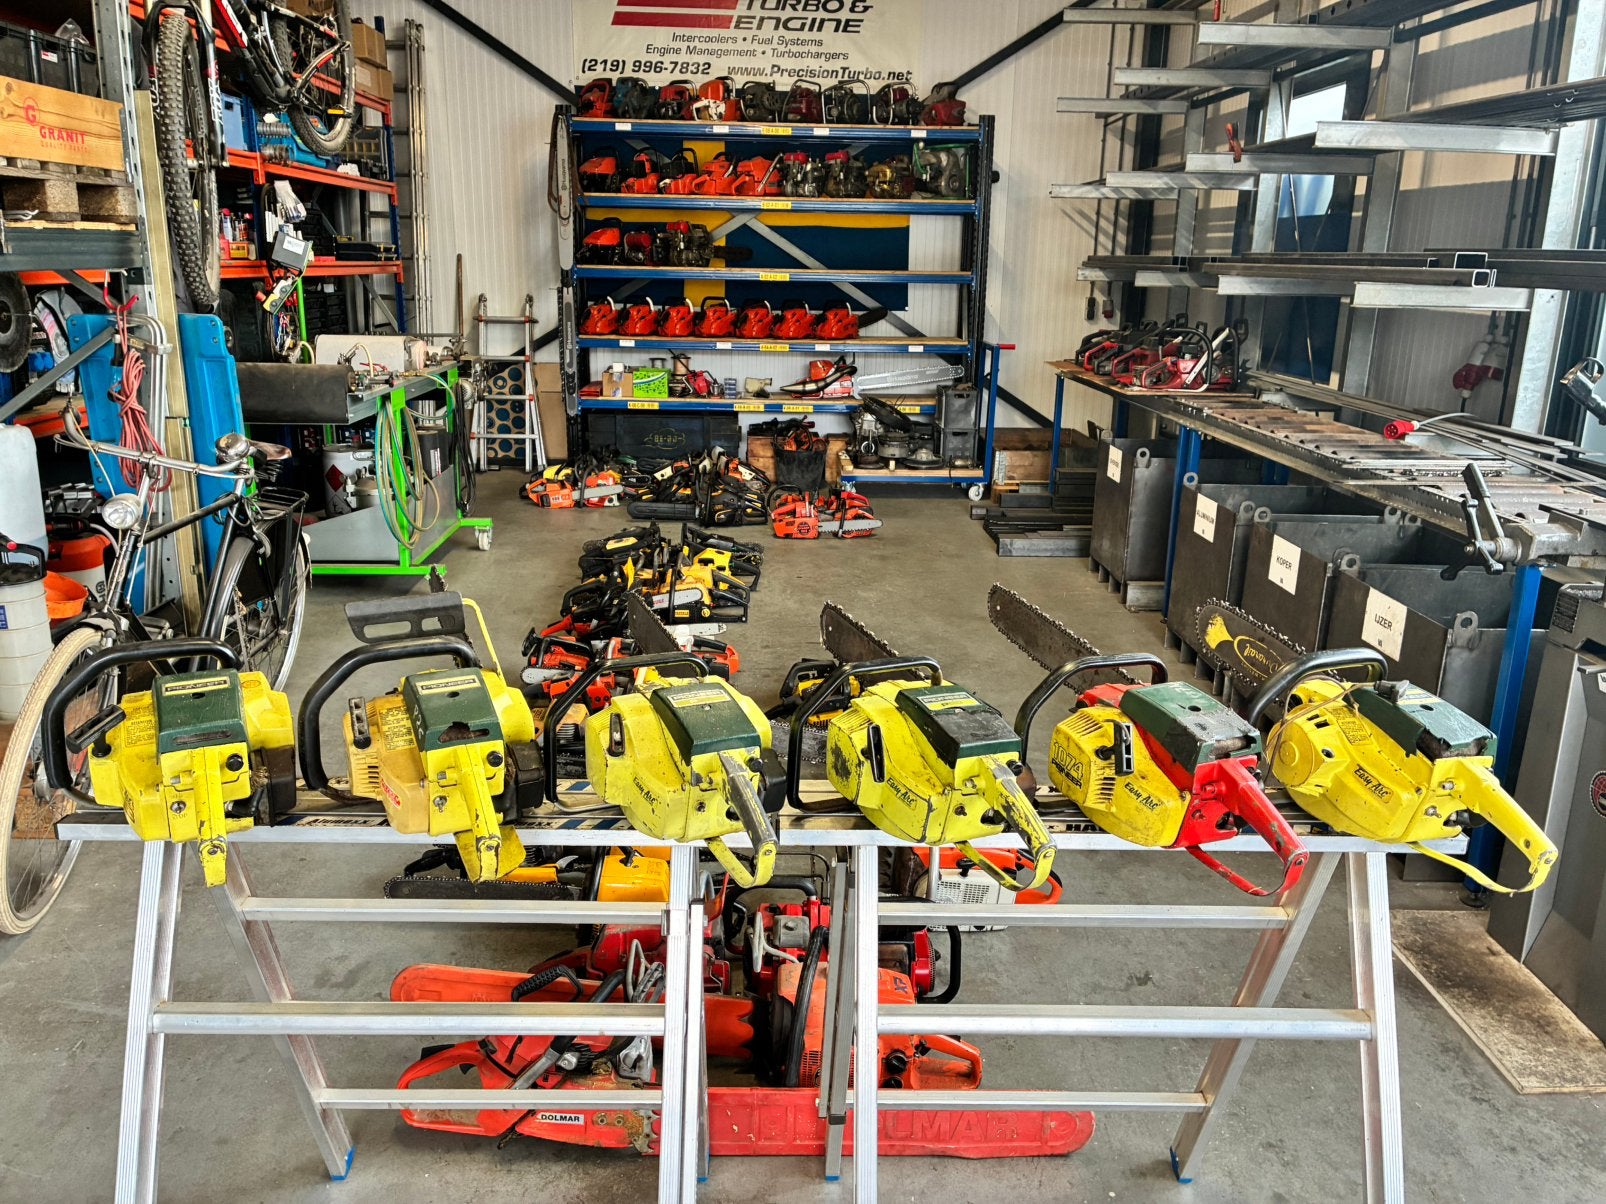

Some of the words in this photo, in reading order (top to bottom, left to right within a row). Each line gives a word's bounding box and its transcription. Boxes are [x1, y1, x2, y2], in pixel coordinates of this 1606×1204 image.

[746, 0, 845, 13] TURBO
[734, 15, 864, 33] ENGINE
[672, 32, 738, 44] Intercoolers
[751, 36, 774, 45] Fuel
[777, 36, 823, 48] Systems
[645, 44, 682, 57] Engine
[685, 46, 757, 58] Management
[771, 48, 849, 62] Turbochargers
[581, 58, 626, 75] (219)
[632, 60, 711, 75] 996-7832
[727, 64, 913, 81] www.PrecisionTurbo.net
[40, 125, 86, 145] GRANIT
[1276, 555, 1292, 572] KOPER
[1374, 613, 1393, 631] IJZER
[167, 680, 227, 692] PIONEER
[421, 678, 476, 691] PIONEER
[1053, 742, 1085, 780] 1074
[1052, 758, 1082, 789] PIONEER
[1354, 765, 1373, 787] Easy
[1368, 780, 1389, 799] Arc
[633, 776, 645, 795] Easy
[643, 790, 656, 804] Arc
[887, 777, 901, 796] Easy
[899, 791, 914, 806] Arc
[1124, 782, 1143, 800] Easy
[1140, 794, 1161, 811] Arc
[540, 1113, 581, 1123] DOLMAR
